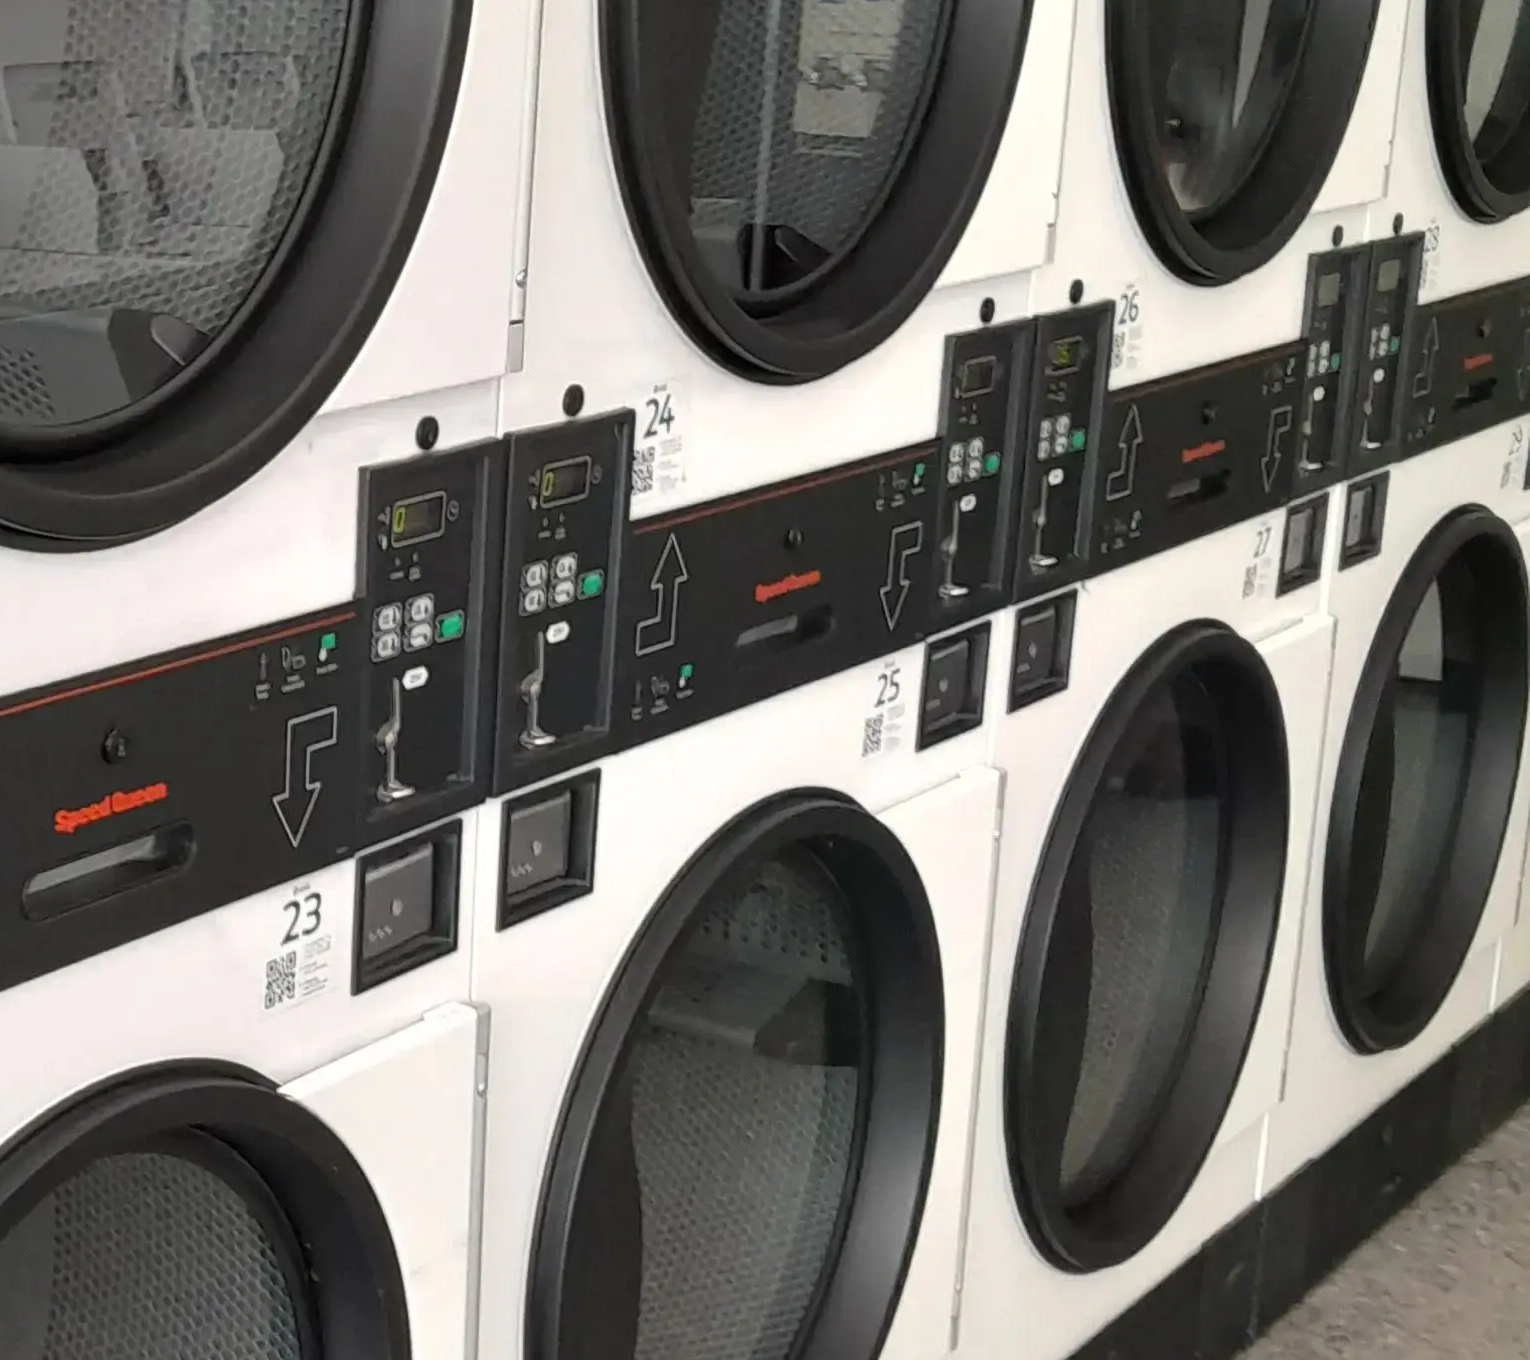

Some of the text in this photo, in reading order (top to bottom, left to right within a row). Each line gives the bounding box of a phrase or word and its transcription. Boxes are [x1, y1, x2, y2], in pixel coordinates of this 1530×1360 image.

[1118, 290, 1139, 325] 26
[643, 393, 675, 439] 24
[874, 668, 901, 708] 25
[280, 892, 322, 947] 23
